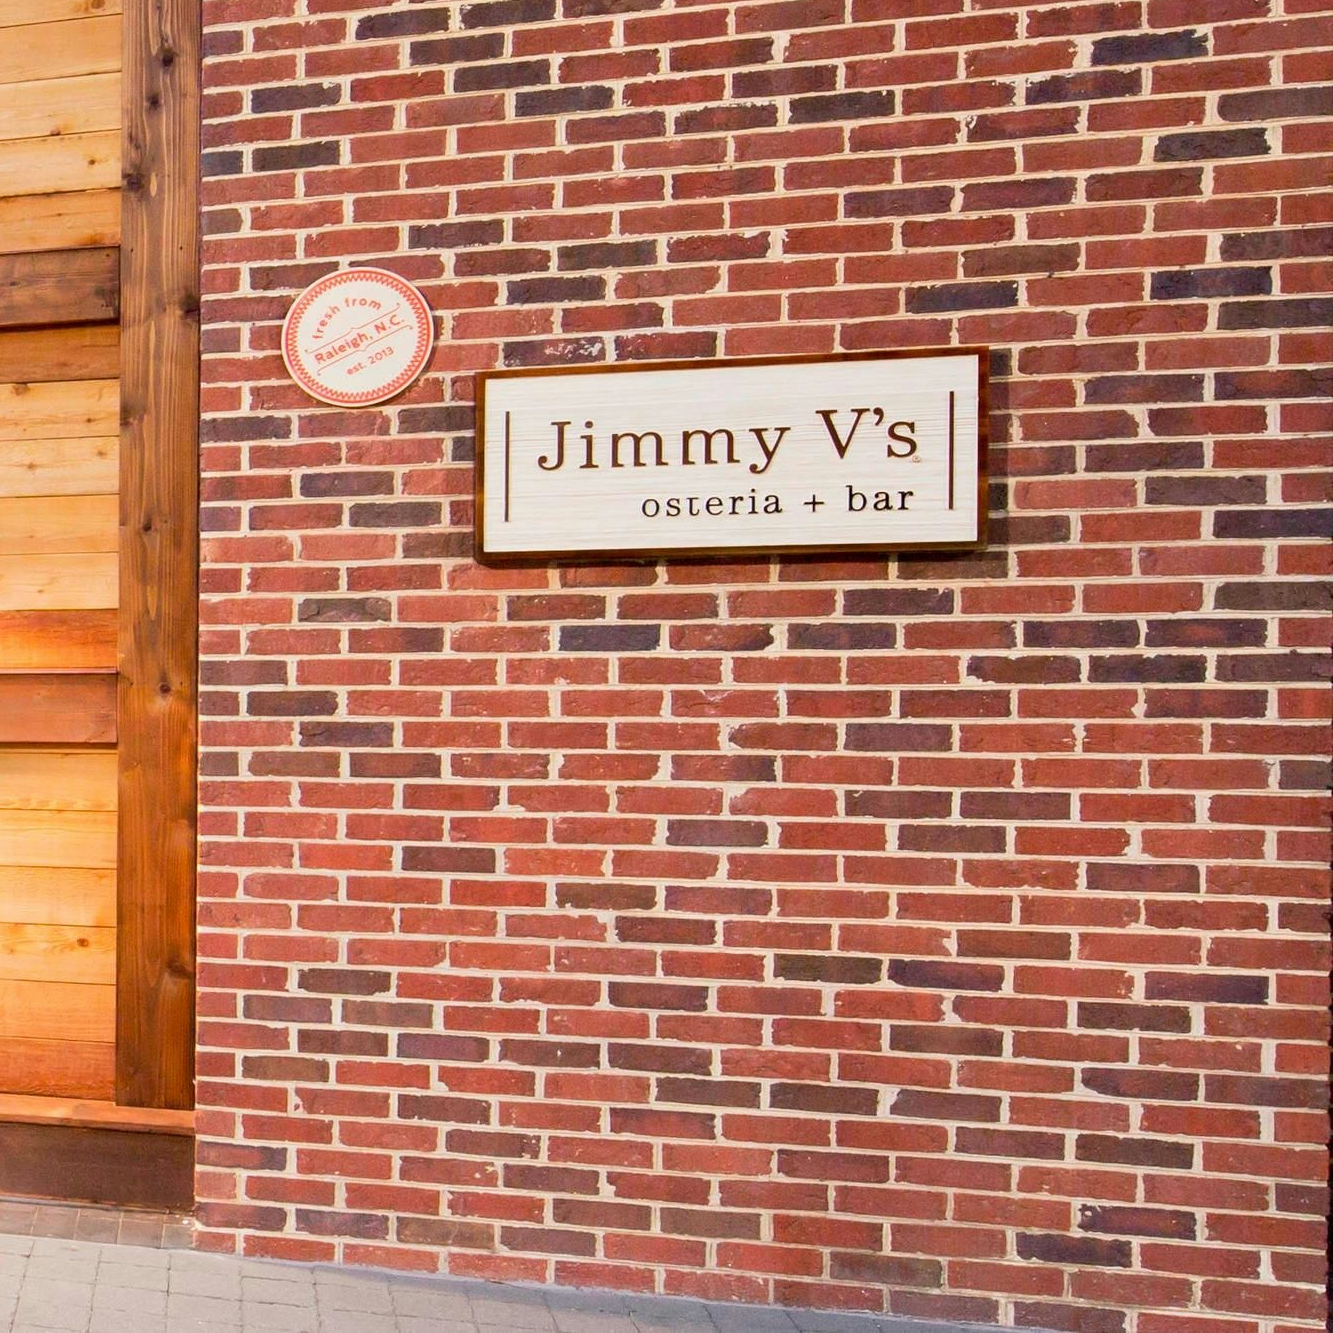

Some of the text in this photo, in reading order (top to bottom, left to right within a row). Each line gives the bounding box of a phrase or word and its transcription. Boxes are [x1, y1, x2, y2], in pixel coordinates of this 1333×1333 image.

[312, 297, 382, 340] fresh from
[314, 314, 405, 365] Raleigh, N.C.
[346, 346, 395, 376] est. 2013
[537, 406, 919, 474] Jimmy V's
[640, 484, 915, 518] osteria + bar
